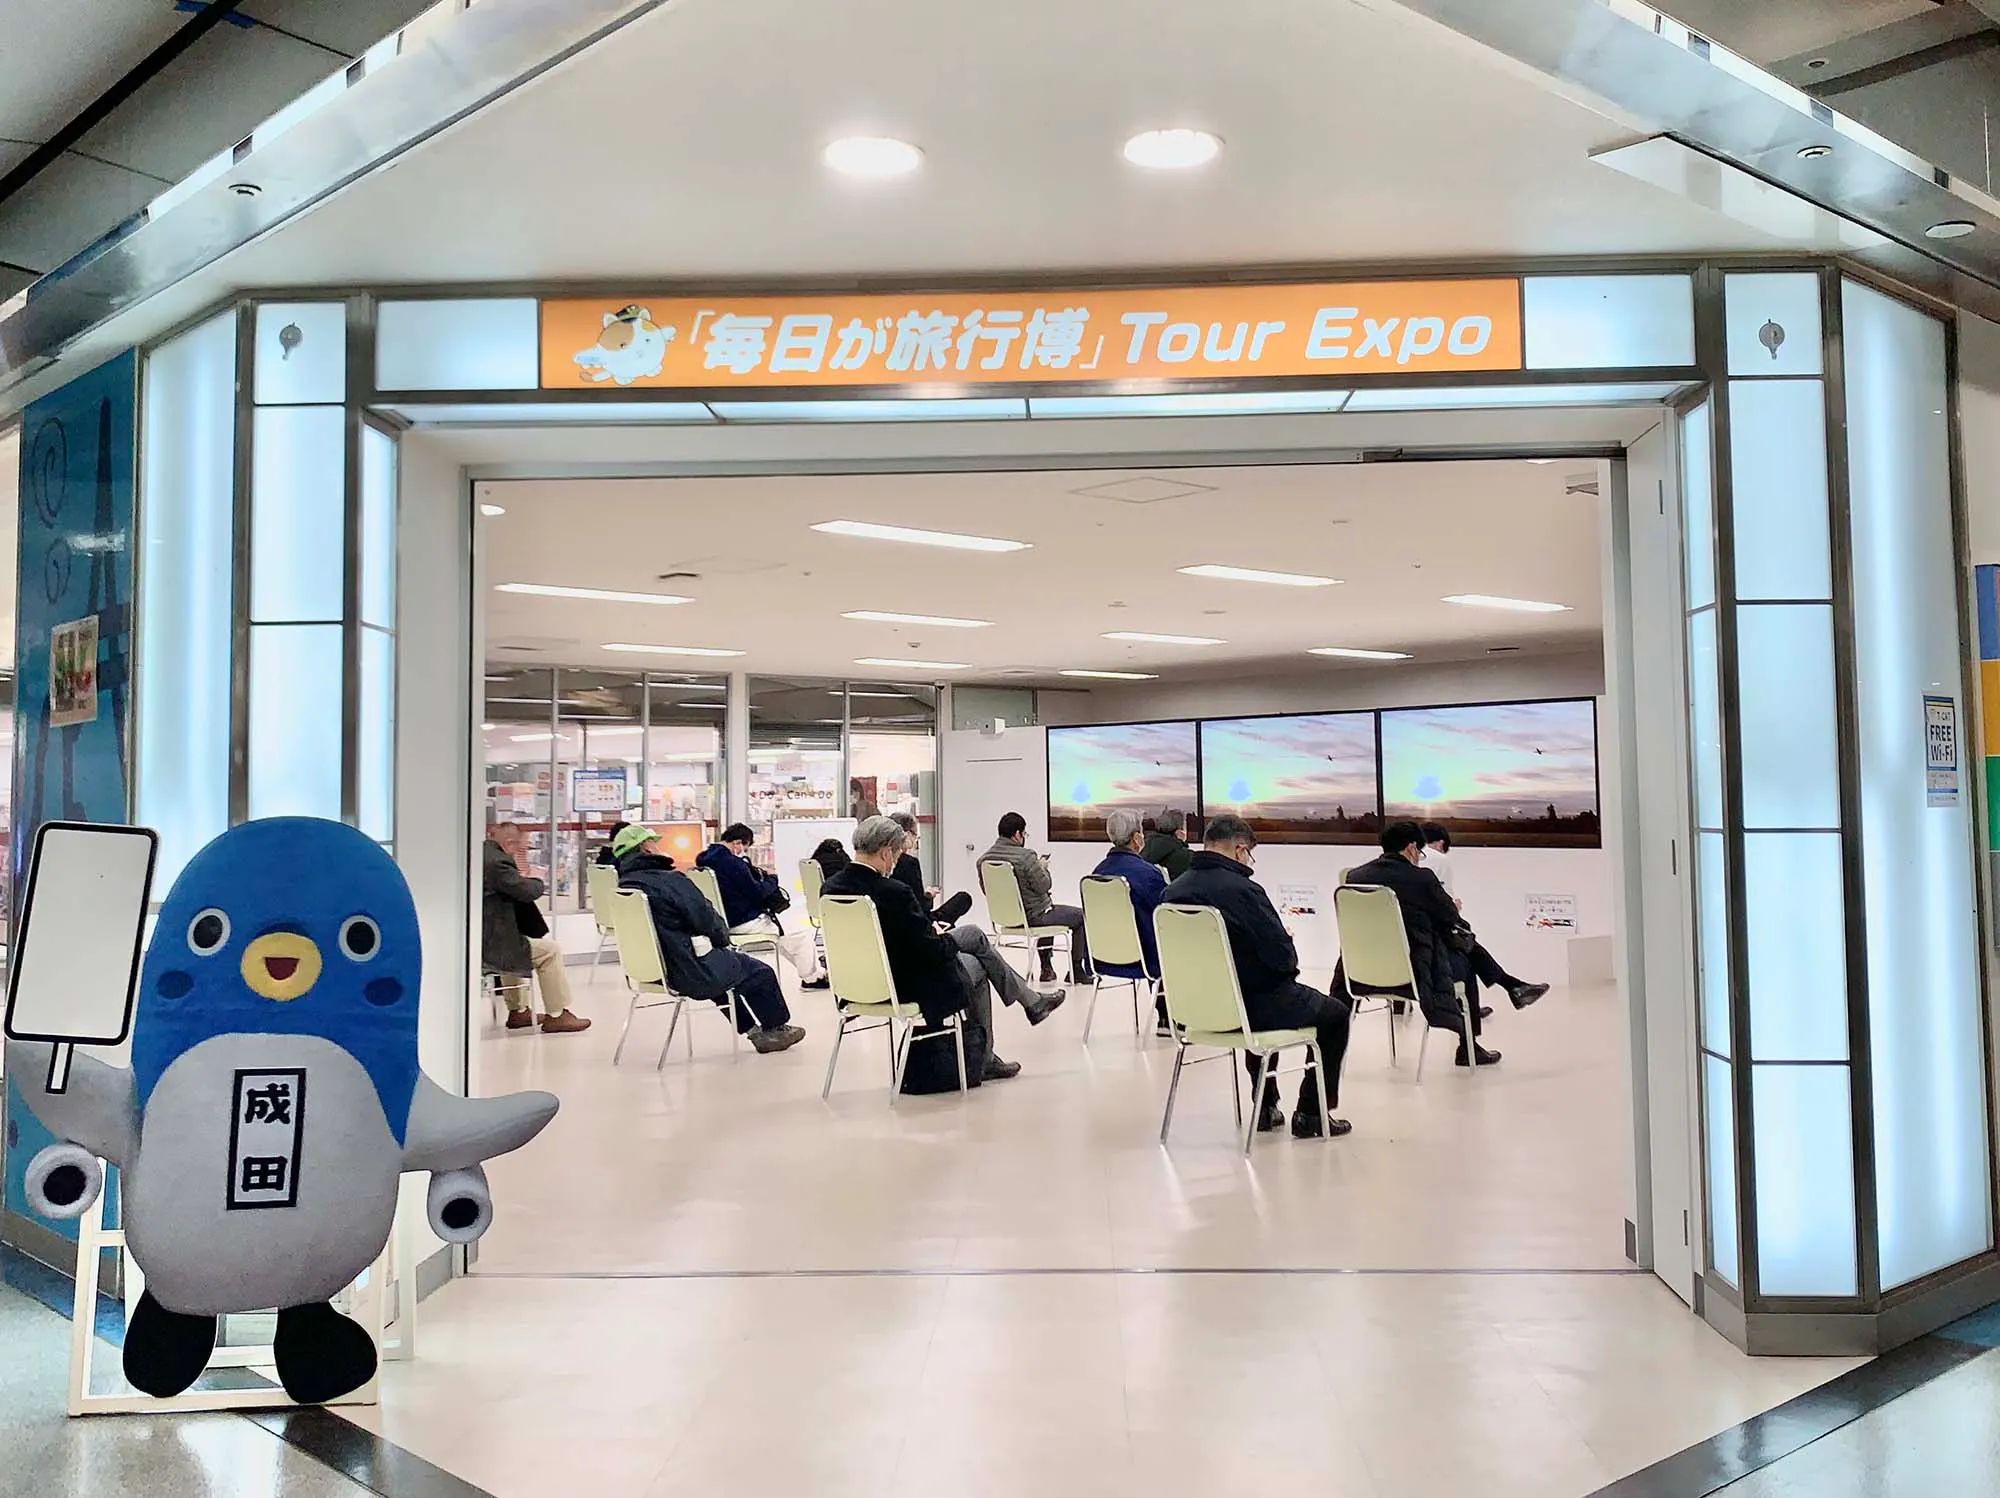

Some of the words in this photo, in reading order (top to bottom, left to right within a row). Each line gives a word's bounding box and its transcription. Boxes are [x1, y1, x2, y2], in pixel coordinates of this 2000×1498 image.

[689, 307, 1105, 375] 「毎日が旅行博」
[1119, 311, 1286, 364] Tour
[1304, 306, 1492, 364] Expo
[1930, 724, 1952, 741] FREE
[1930, 743, 1953, 761] Wi-Fi
[240, 1082, 292, 1193] 成田
